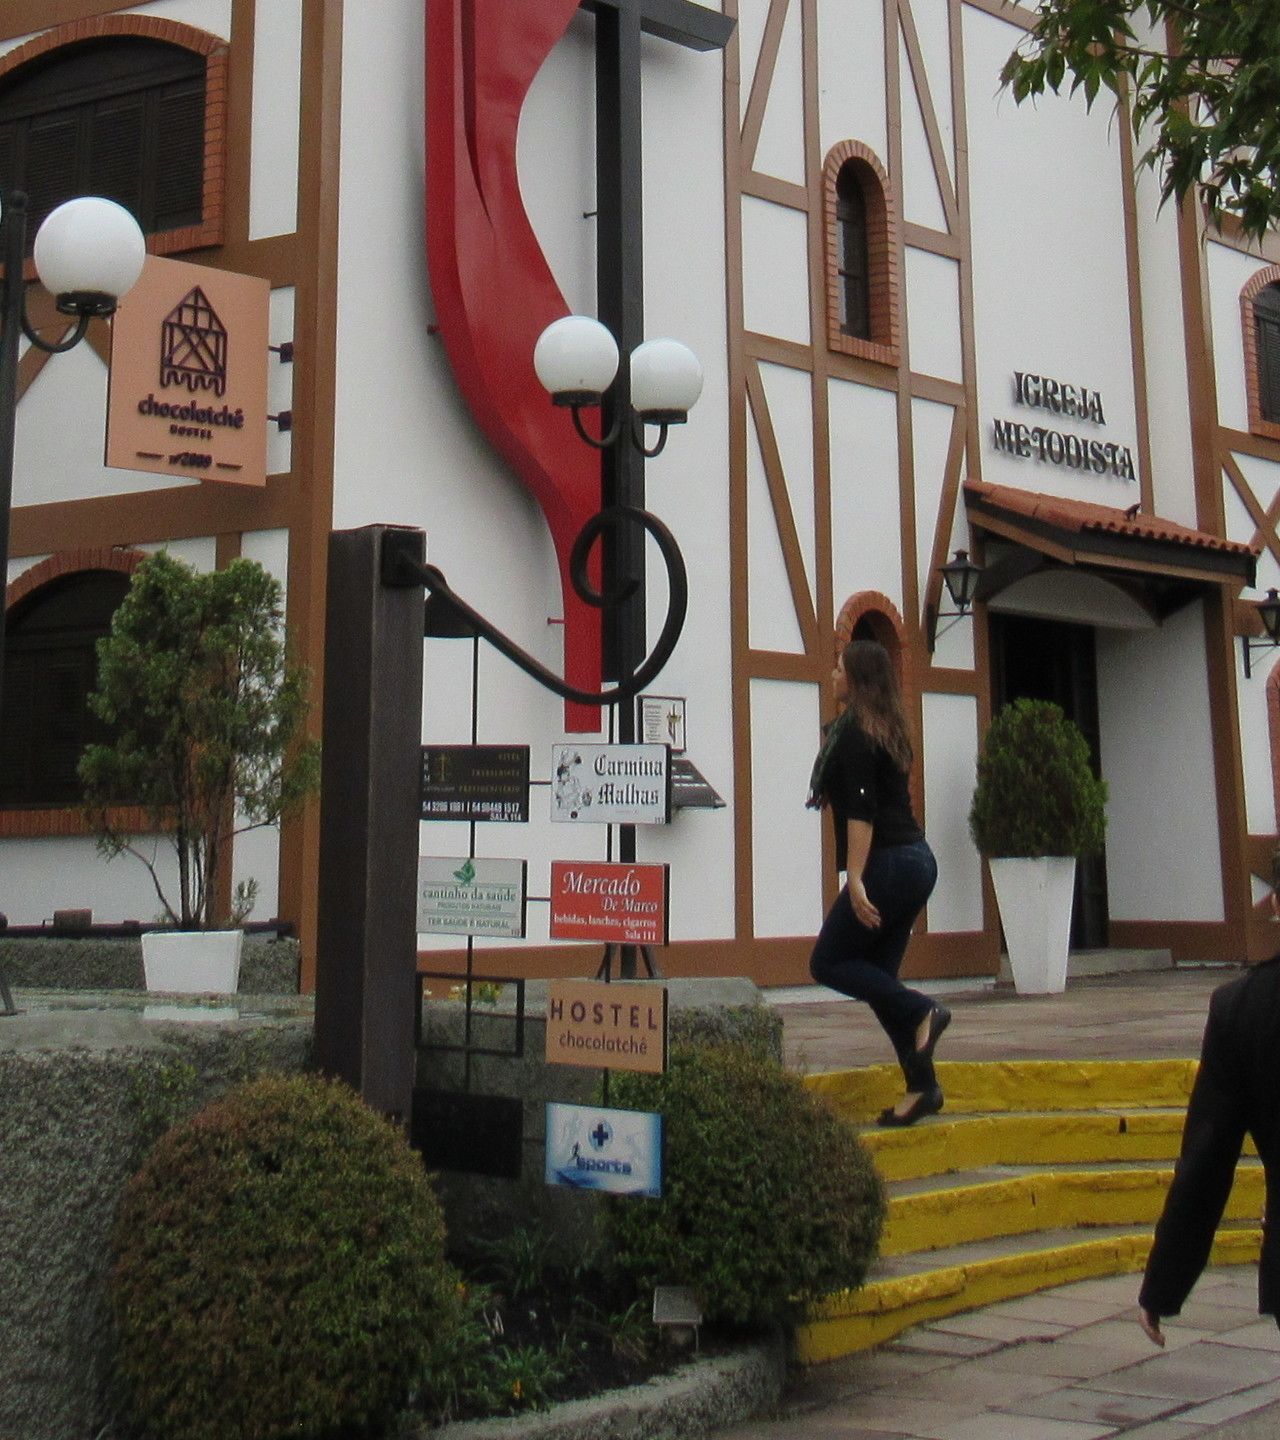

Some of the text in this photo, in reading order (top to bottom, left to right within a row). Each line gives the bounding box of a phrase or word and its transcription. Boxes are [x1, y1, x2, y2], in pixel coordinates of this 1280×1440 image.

[1012, 370, 1106, 426] IGREJA
[169, 424, 214, 440] HOSTEL
[993, 417, 1136, 482] METODISTA
[594, 753, 664, 777] Carmina
[597, 781, 659, 806] Malhas
[422, 886, 517, 902] cantinho da saúde
[561, 870, 641, 896] Mercado
[602, 896, 659, 913] De Marco
[553, 912, 588, 926] bebidas,
[622, 916, 658, 929] cigarros
[624, 929, 641, 940] Sala
[550, 998, 658, 1031] HOSTEL
[558, 1030, 648, 1055] chocolatchê
